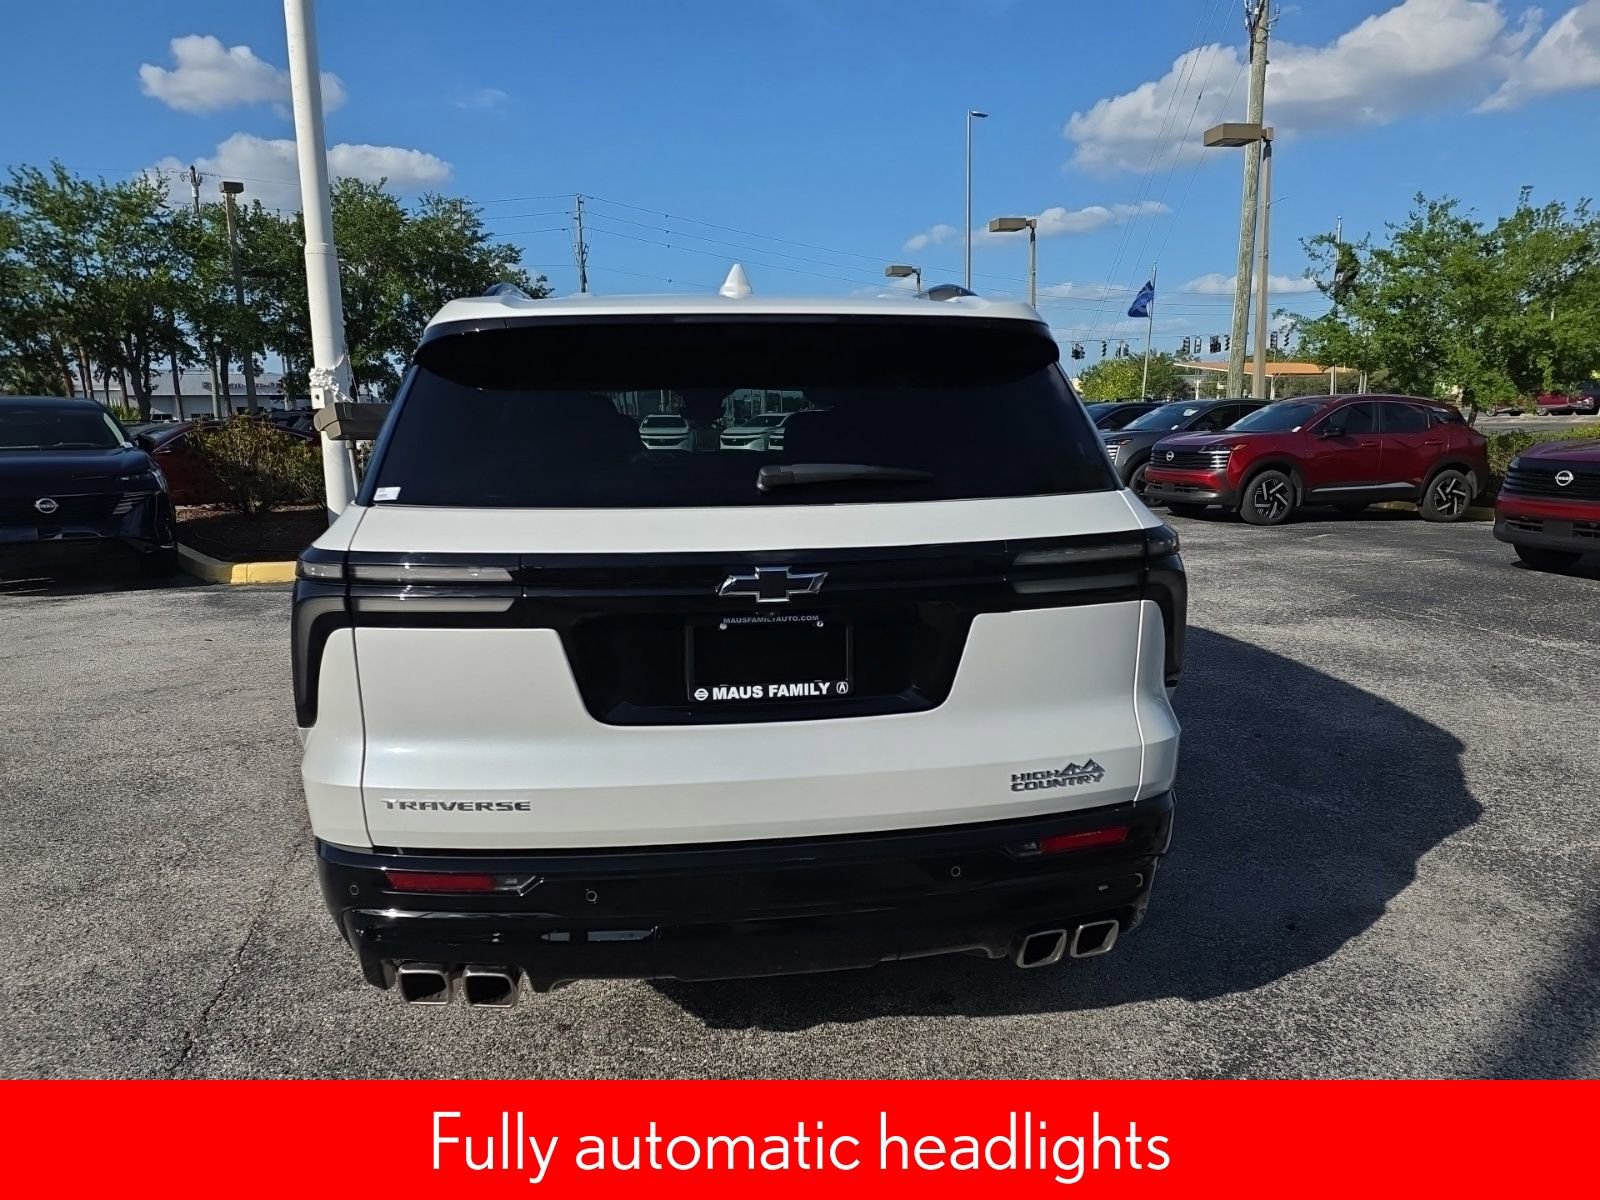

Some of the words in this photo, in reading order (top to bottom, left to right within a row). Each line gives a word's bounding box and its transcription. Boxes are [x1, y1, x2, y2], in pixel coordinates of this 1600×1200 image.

[722, 615, 820, 625] MAUSFAMILYAUTO.COM
[712, 685, 764, 700] MAUS
[768, 682, 831, 698] FAMILY
[1010, 769, 1061, 782] HIGH
[1010, 772, 1105, 792] COUNTRY
[382, 800, 532, 812] TRAVERSE
